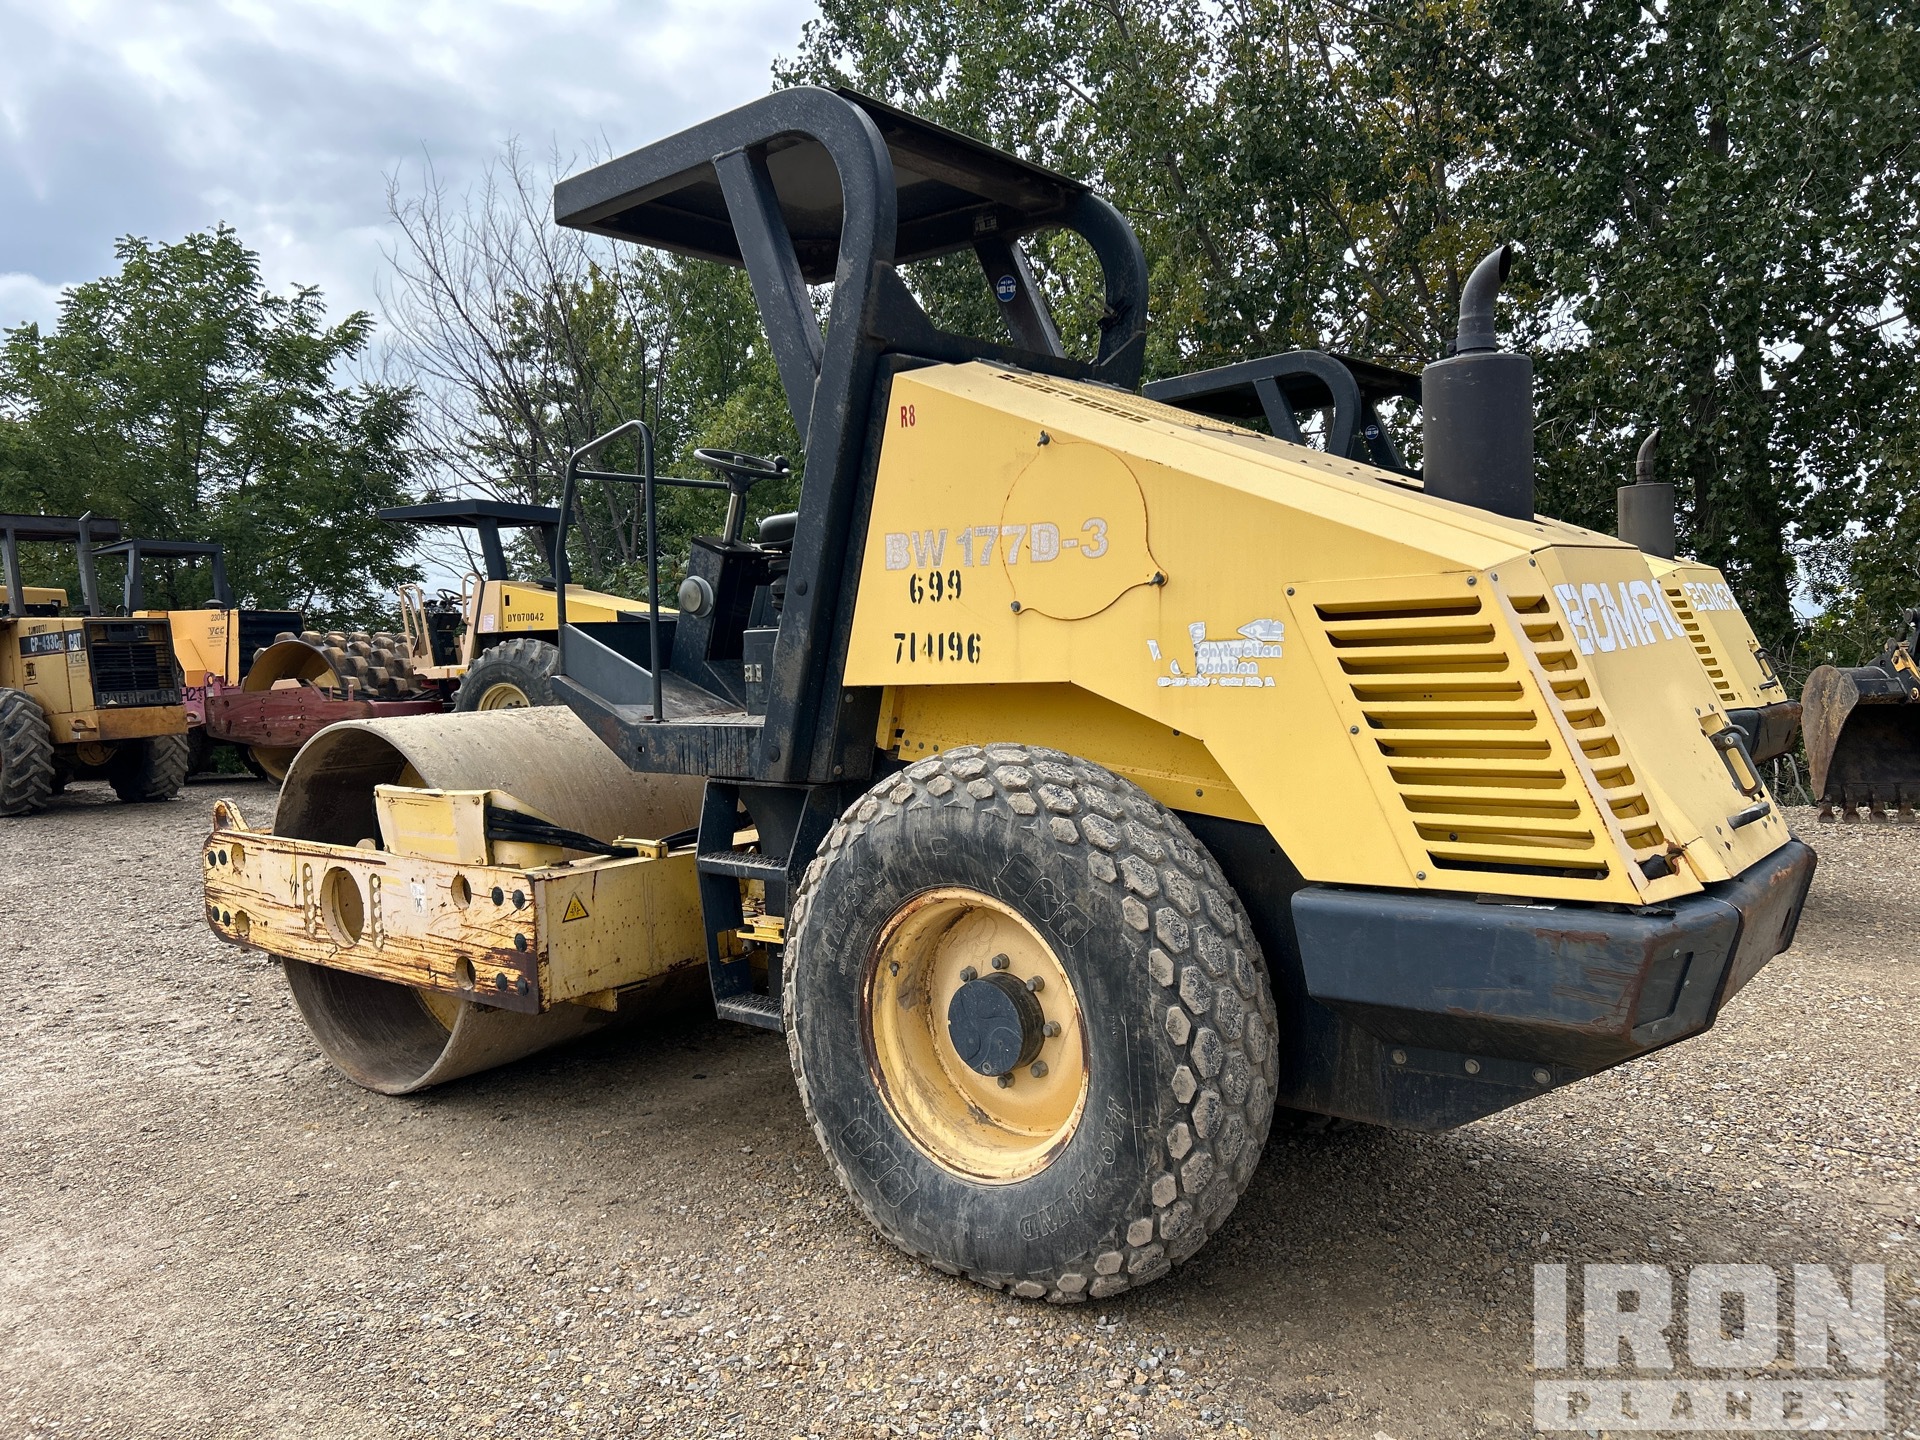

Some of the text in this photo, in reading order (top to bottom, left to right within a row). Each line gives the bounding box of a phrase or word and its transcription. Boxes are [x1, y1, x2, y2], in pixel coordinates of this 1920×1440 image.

[900, 404, 916, 428] R8
[885, 517, 1110, 571] BW 177D-3
[909, 569, 962, 604] 699
[68, 632, 81, 651] CAT
[894, 632, 982, 664] 714196
[101, 690, 176, 706] CATERPILLAR
